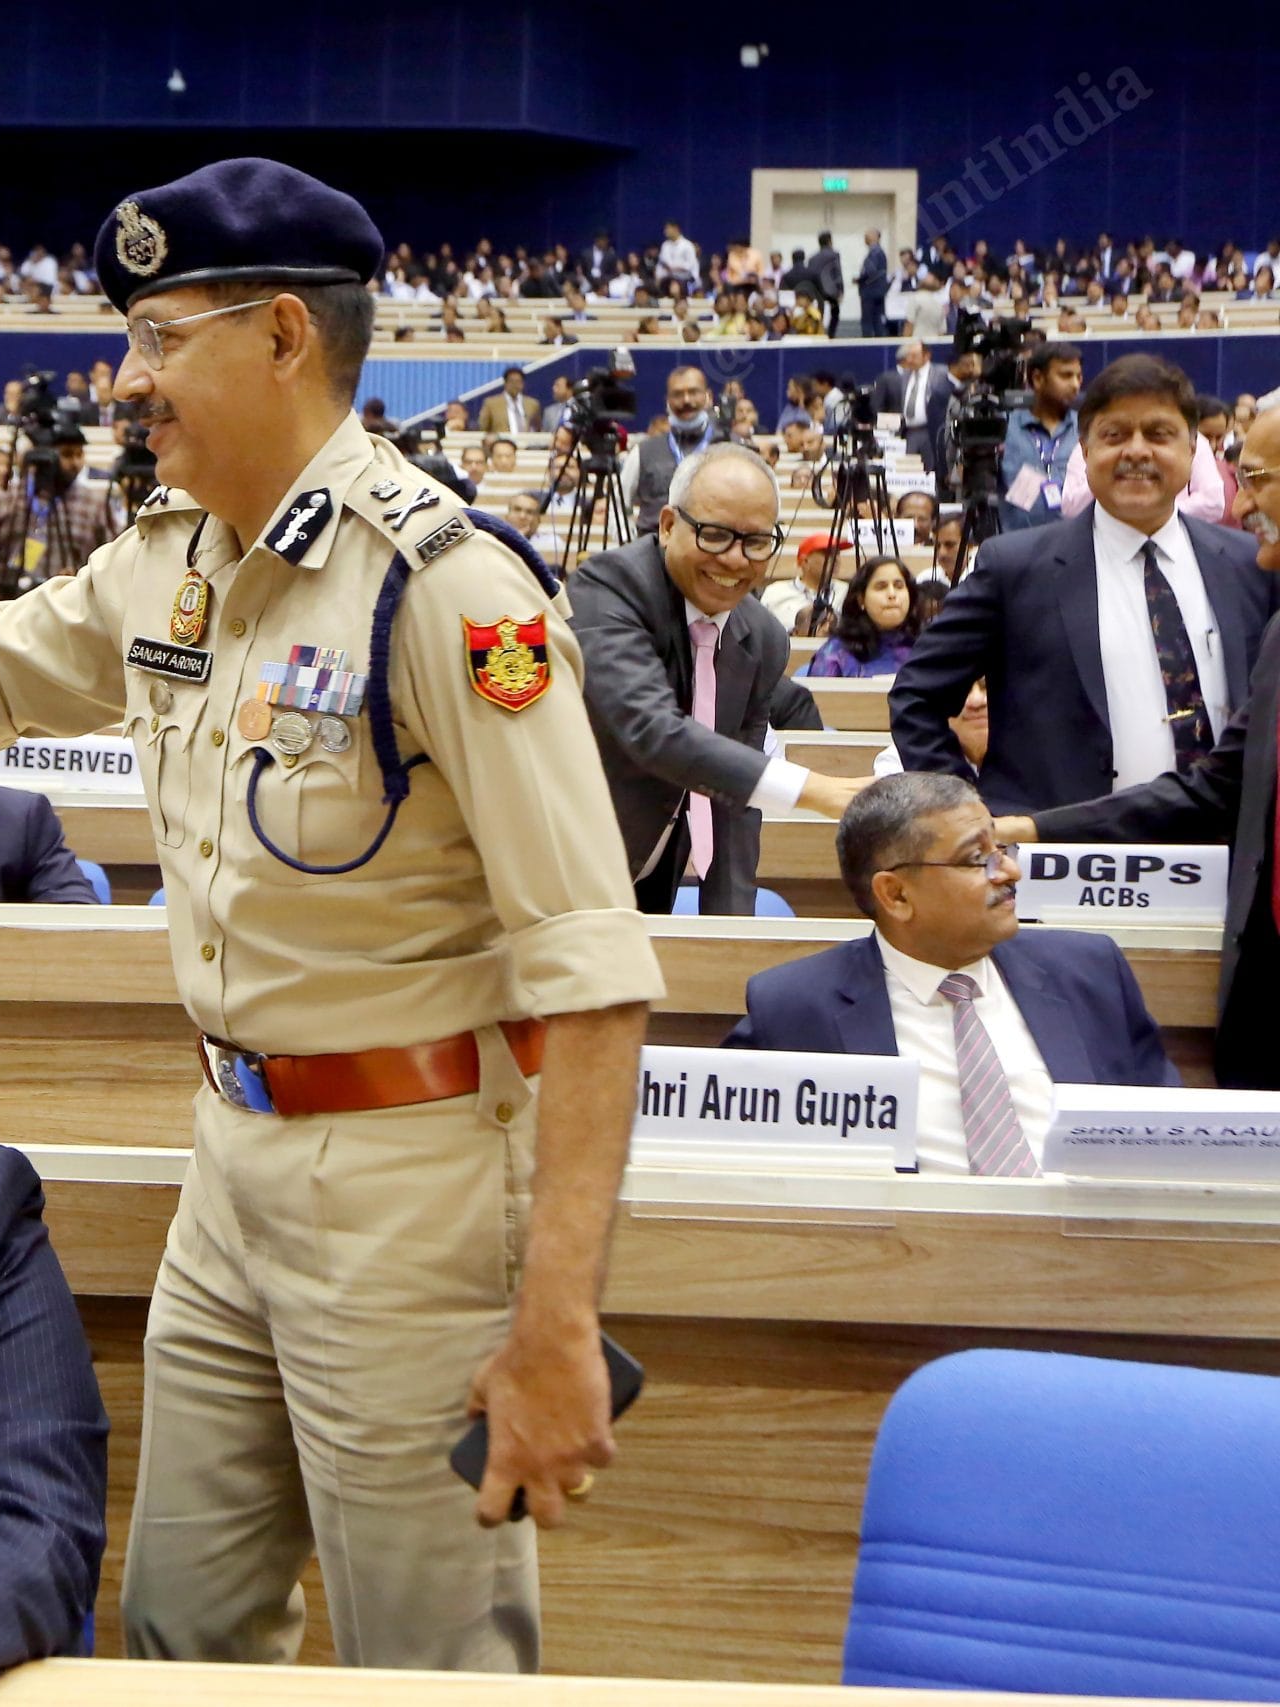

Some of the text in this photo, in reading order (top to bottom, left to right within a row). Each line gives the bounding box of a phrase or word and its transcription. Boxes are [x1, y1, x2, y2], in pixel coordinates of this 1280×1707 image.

[129, 645, 202, 673] SANJAY ARORA
[5, 746, 133, 775] RESERVED
[1030, 853, 1202, 885] DGPs
[1078, 886, 1150, 908] ACBs
[638, 1070, 897, 1138] hri Arun Gupta
[1069, 1126, 1135, 1135] SHRI
[1144, 1126, 1160, 1135] V
[1167, 1126, 1185, 1136] S
[1194, 1126, 1211, 1136] K
